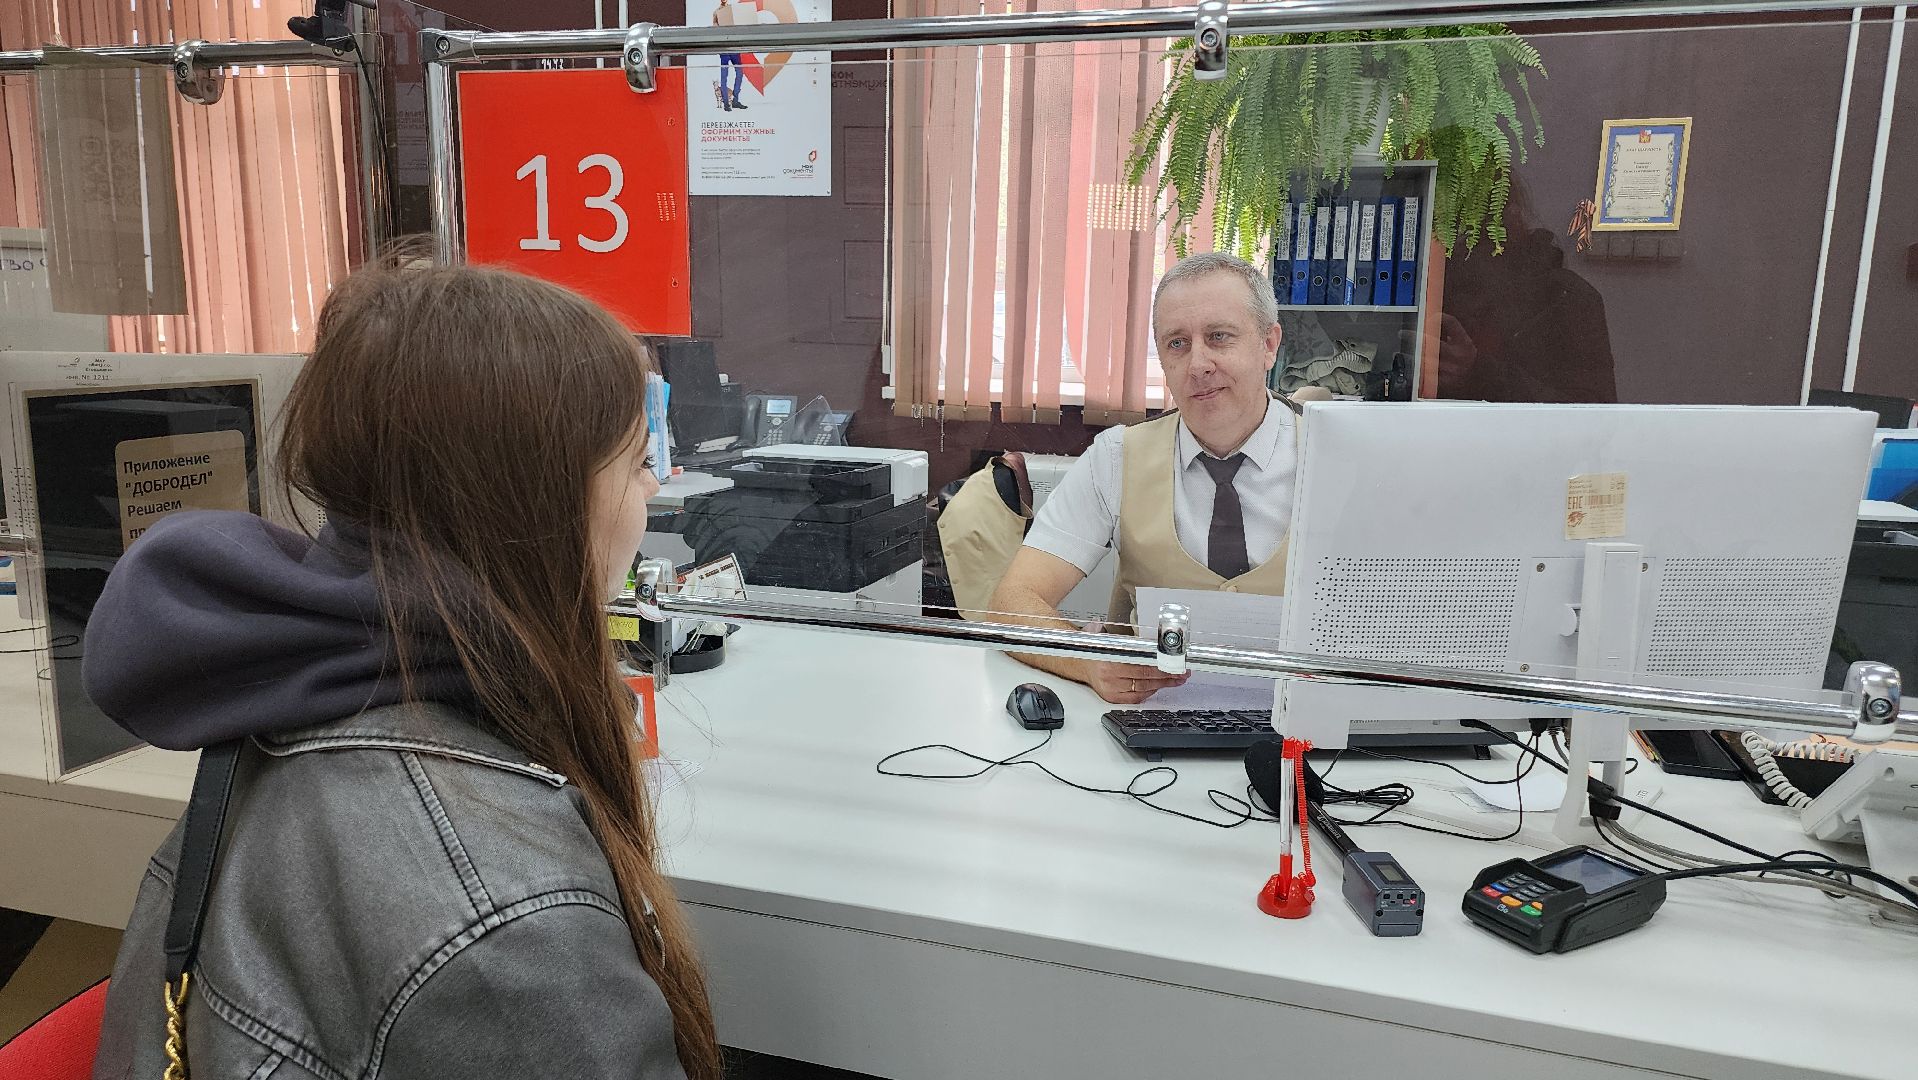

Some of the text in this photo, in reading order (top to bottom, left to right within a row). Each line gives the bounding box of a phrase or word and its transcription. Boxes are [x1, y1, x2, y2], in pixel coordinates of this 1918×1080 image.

[701, 121, 755, 129] ПЕРЕЕЗЖАЕТЕ?
[516, 153, 629, 253] 13
[124, 454, 210, 476] Приложение
[126, 471, 213, 498] "ДОБРОДЕЛ"
[127, 500, 182, 517] Решаем
